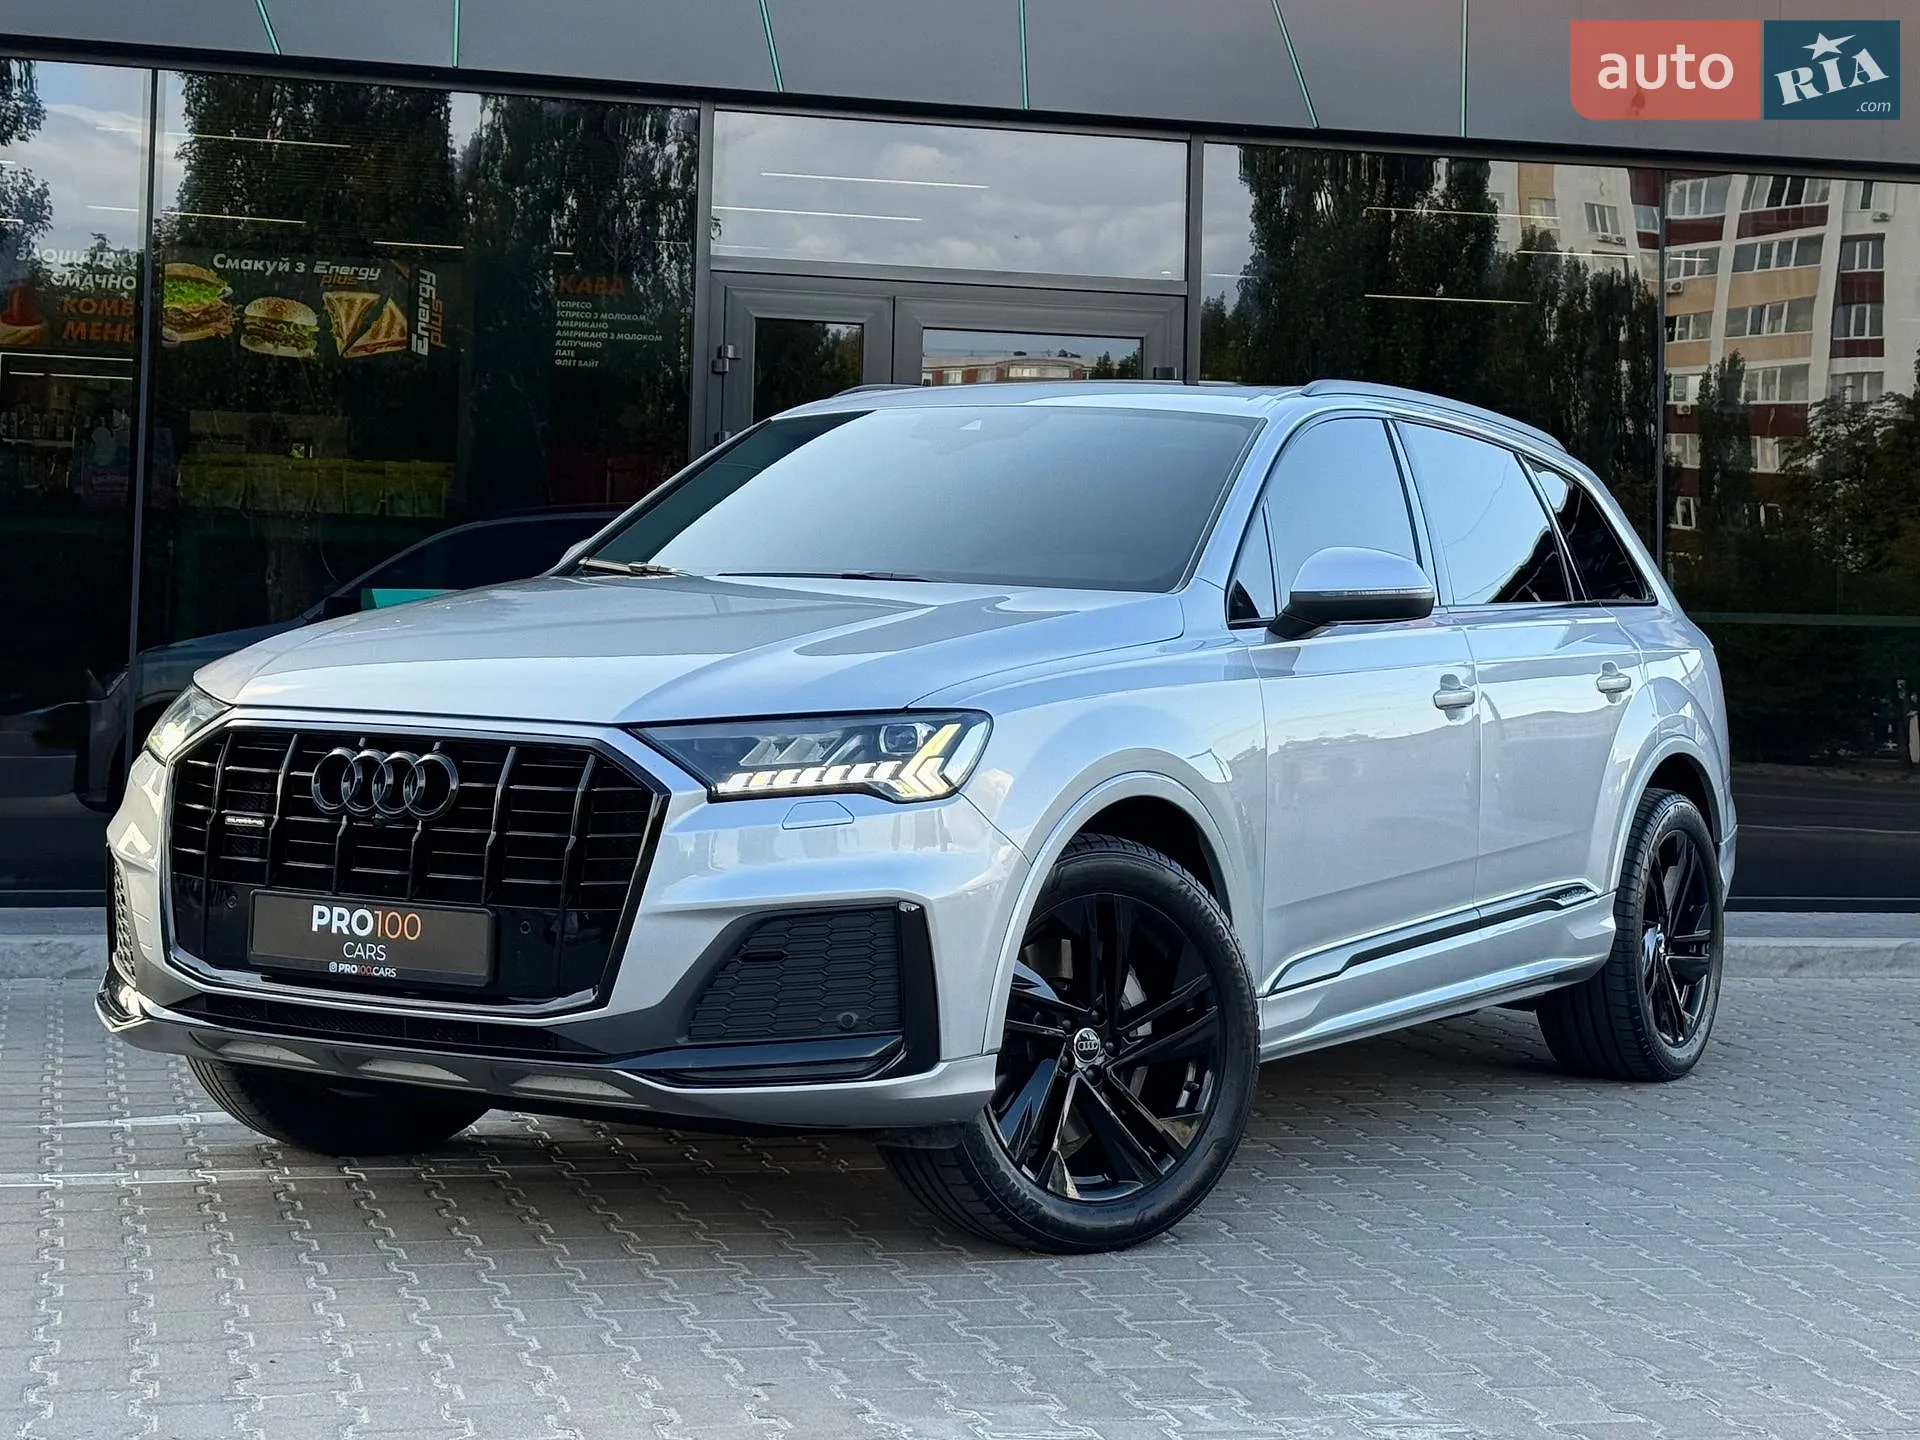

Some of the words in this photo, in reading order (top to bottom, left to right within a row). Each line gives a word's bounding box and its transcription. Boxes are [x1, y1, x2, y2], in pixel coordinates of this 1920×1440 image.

[212, 253, 290, 276] Смакуй
[295, 260, 305, 273] з
[313, 260, 381, 281] Energy
[50, 271, 137, 290] СМАЧНО
[319, 274, 358, 286] plus
[556, 300, 592, 309] ЕСПРЕСО
[411, 269, 437, 356] Energy
[556, 310, 592, 319] ЕСПРЕСО
[430, 298, 447, 348] plus
[555, 320, 608, 329] АМЕРИКАНО
[555, 330, 608, 339] АМЕРИКАНО
[616, 332, 663, 341] МОЛОКОМ
[555, 340, 602, 349] КАПУЧИНО
[554, 349, 575, 357] ЛАТЕ
[311, 905, 422, 941] PRO100
[343, 941, 387, 961] CARS
